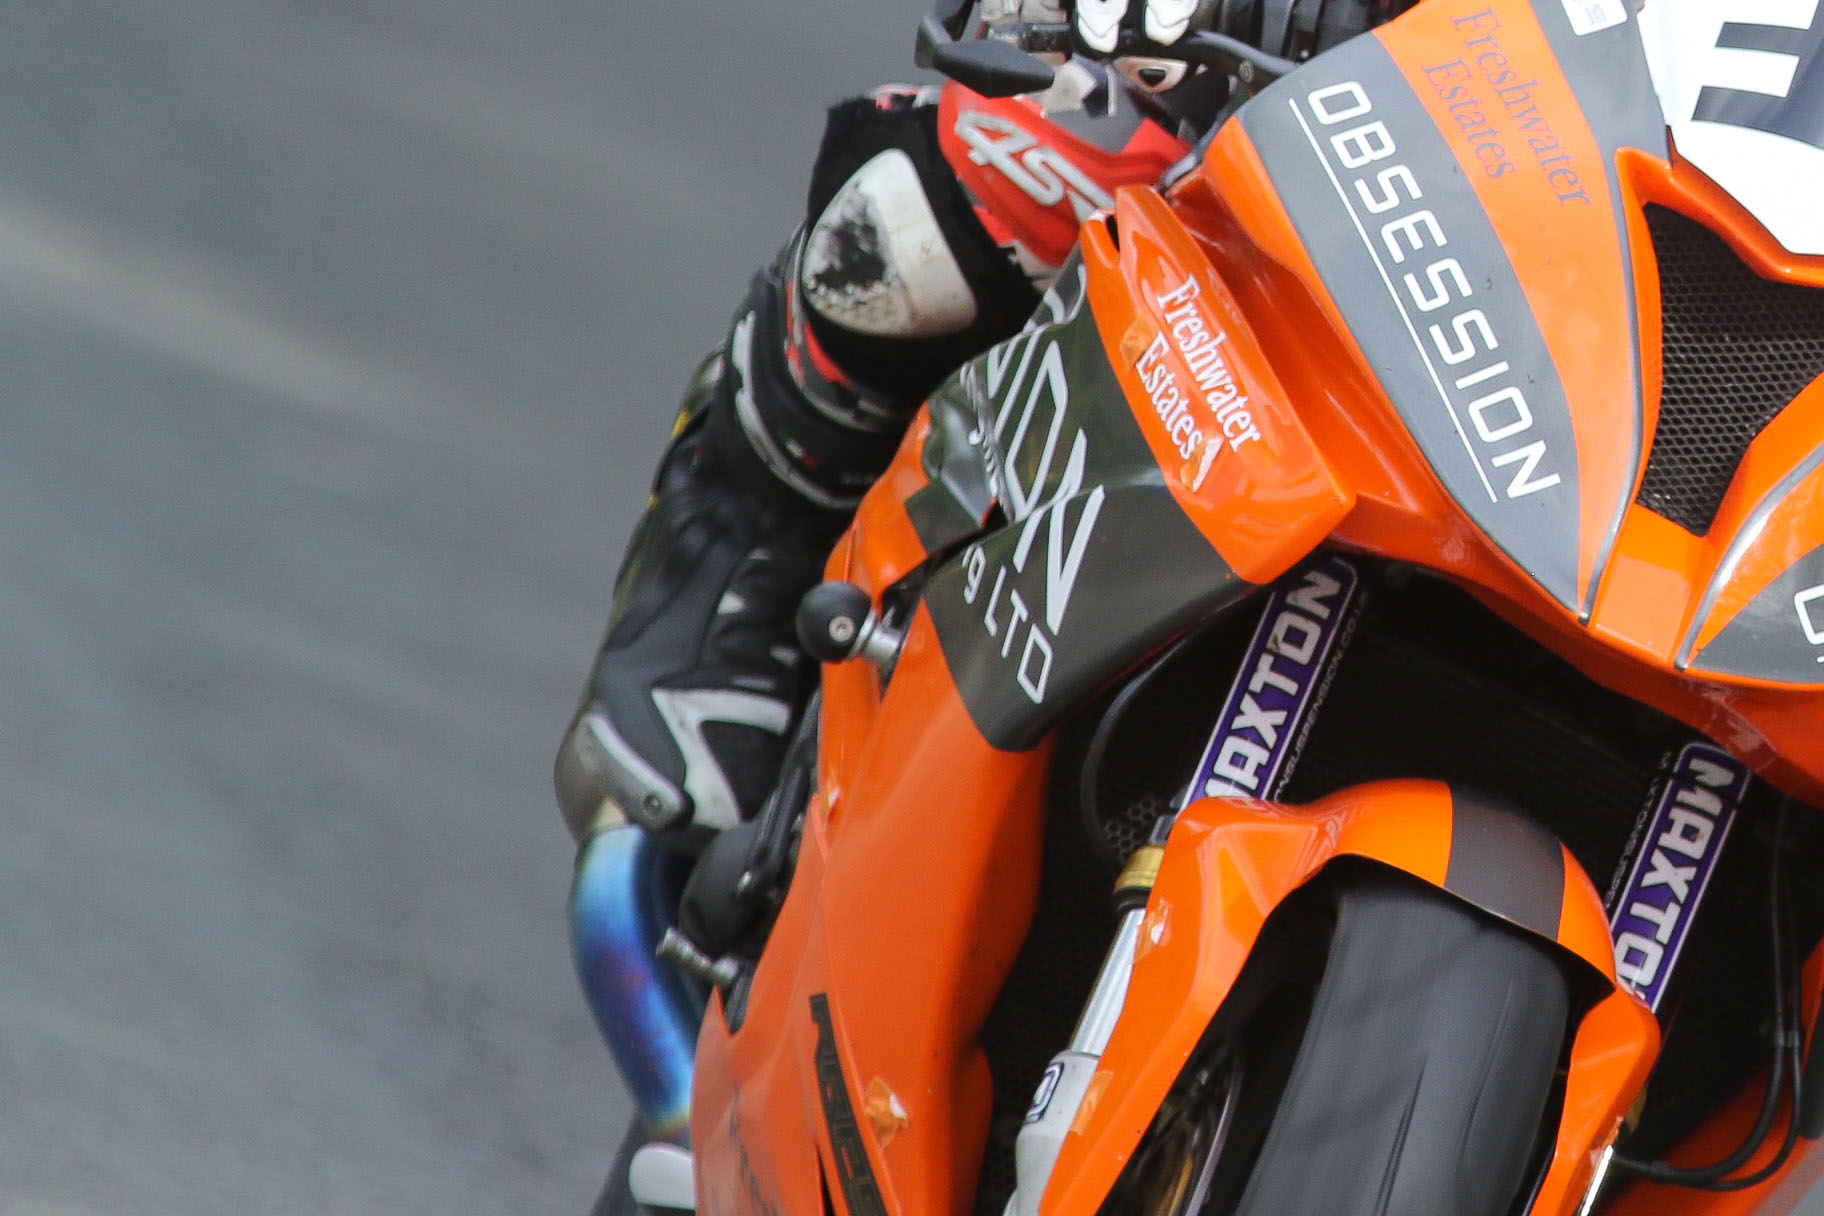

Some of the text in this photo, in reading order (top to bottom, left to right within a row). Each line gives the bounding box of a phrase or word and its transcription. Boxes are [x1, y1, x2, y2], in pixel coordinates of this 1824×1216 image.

[1421, 56, 1518, 180] Estates
[1450, 6, 1593, 208] Freshwater
[1156, 273, 1262, 453] Freshwater
[1306, 80, 1561, 500] OBSESSION
[1135, 330, 1204, 460] Estates
[1612, 757, 1736, 1001] MAXTO
